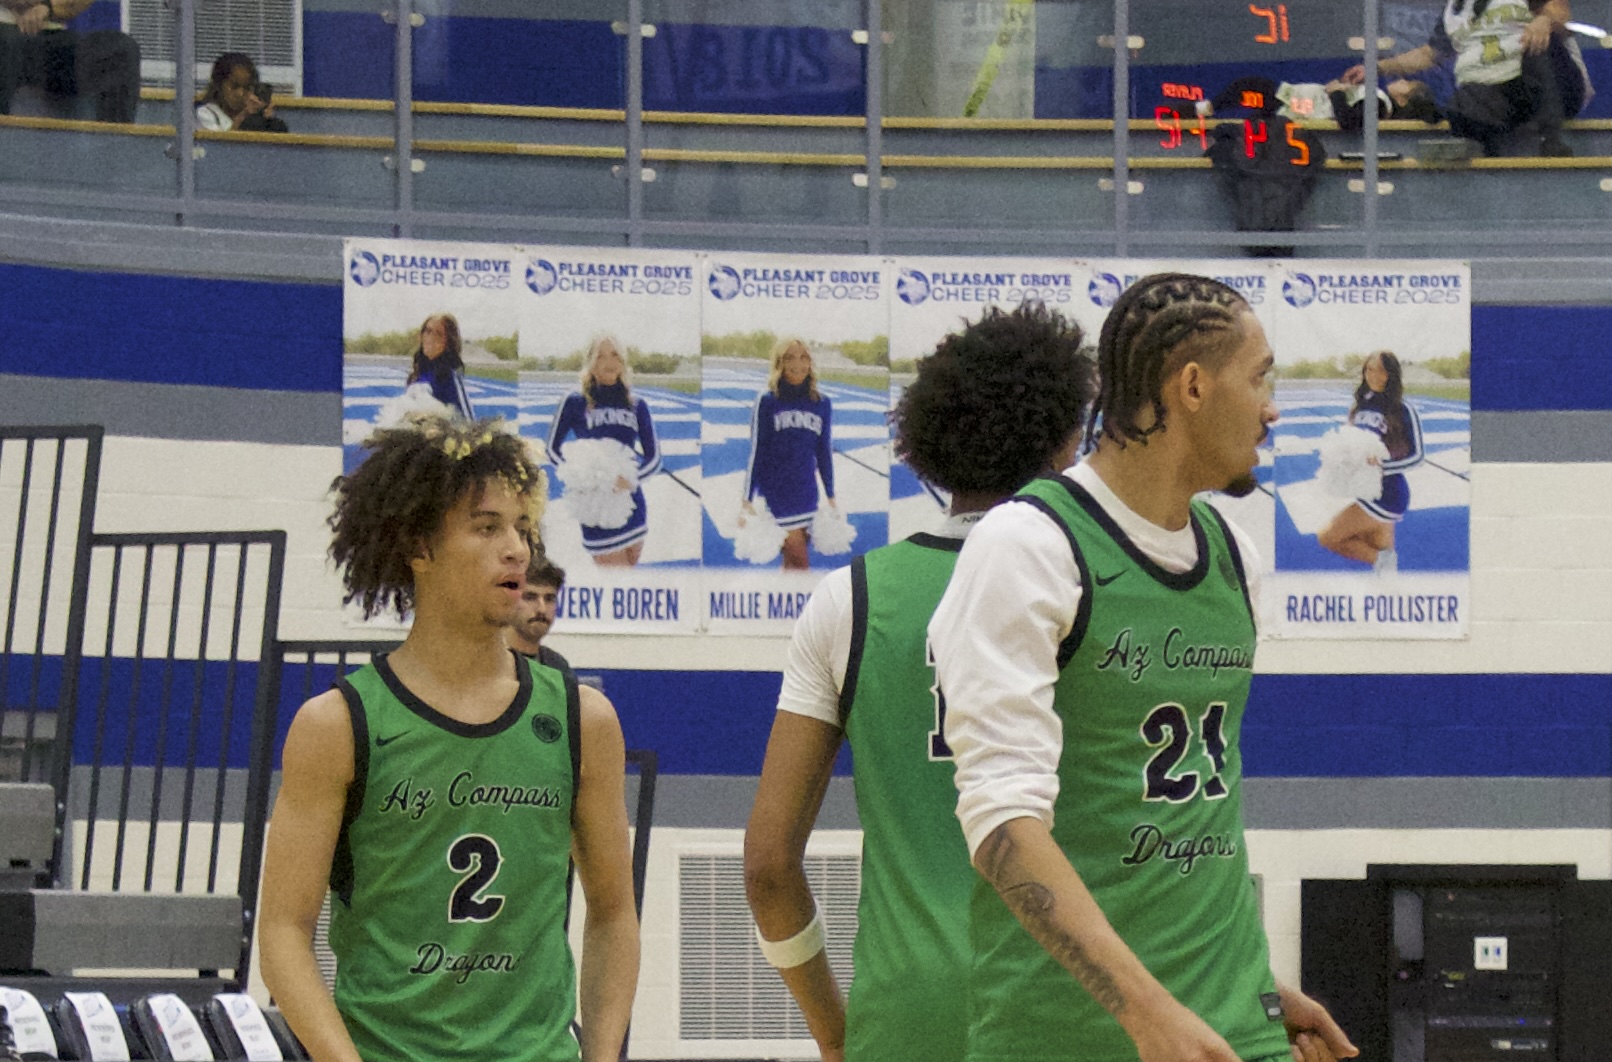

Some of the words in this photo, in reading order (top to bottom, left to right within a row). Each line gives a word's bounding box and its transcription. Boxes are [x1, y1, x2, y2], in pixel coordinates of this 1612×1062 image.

[382, 254, 458, 271] PLEASANT
[464, 258, 510, 273] GROVE
[558, 262, 638, 279] PLEASANT
[643, 265, 693, 280] GROVE
[381, 269, 445, 286] CHEER
[450, 273, 510, 290] 2025
[743, 268, 826, 284] PLEASANT
[830, 270, 880, 285] GROVE
[931, 273, 1016, 287] PLEASANT
[1021, 274, 1072, 287] GROVE
[1318, 275, 1405, 288] PLEASANT
[1409, 275, 1461, 288] GROVE
[557, 277, 625, 294] CHEER
[629, 279, 692, 297] 2025
[742, 283, 811, 299] CHEER
[815, 285, 880, 301] 2025
[931, 287, 1000, 302] CHEER
[1006, 288, 1072, 302] 2025
[1318, 289, 1389, 304] CHEER
[1394, 289, 1460, 304] 2025
[555, 587, 604, 619] VERY
[612, 588, 679, 621] BOREN
[709, 591, 761, 619] MILLIE
[1286, 595, 1356, 622] RACHEL
[1363, 595, 1459, 622] POLLISTER
[1097, 628, 1152, 682] Az
[379, 777, 435, 821] Az
[447, 771, 563, 814] Compass
[447, 833, 505, 923] 2
